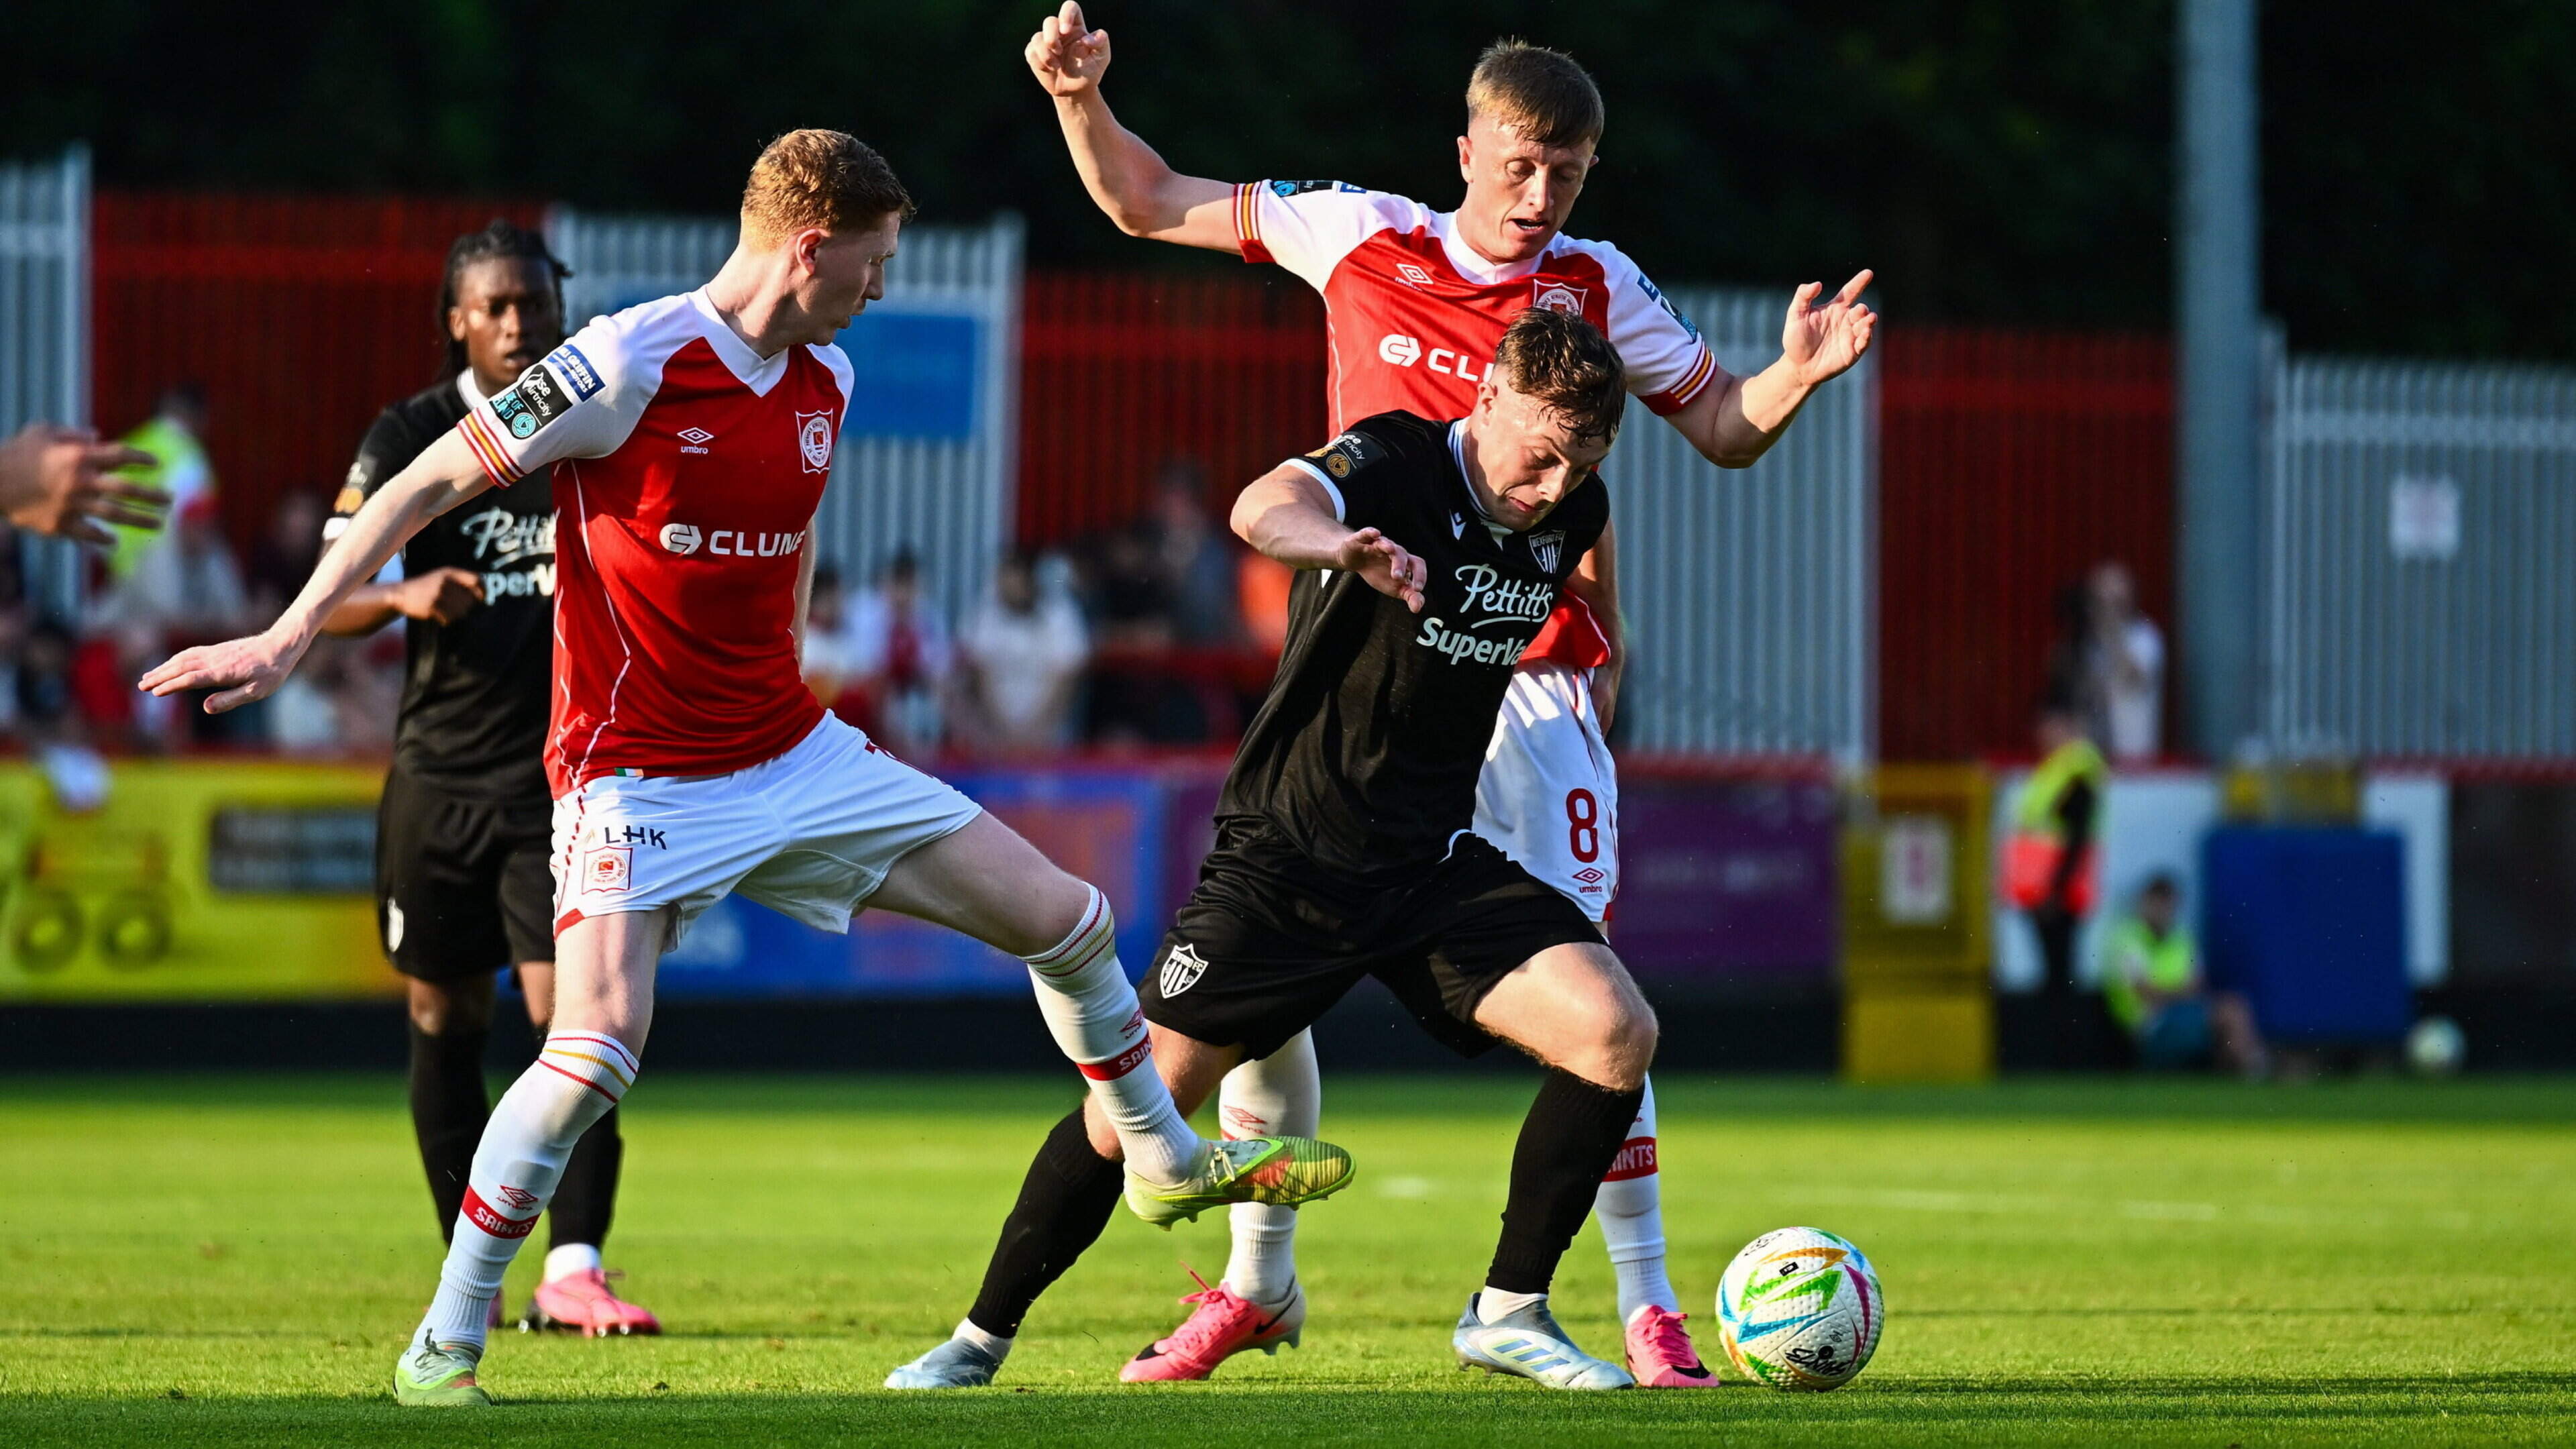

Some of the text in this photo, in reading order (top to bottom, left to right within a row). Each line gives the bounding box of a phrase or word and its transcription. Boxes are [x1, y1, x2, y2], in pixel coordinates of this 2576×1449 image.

[568, 355, 596, 390] GRIFFIN
[680, 445, 709, 455] umbro
[604, 825, 667, 851] LHK
[1565, 788, 1599, 863] 8
[1578, 884, 1603, 894] umbro
